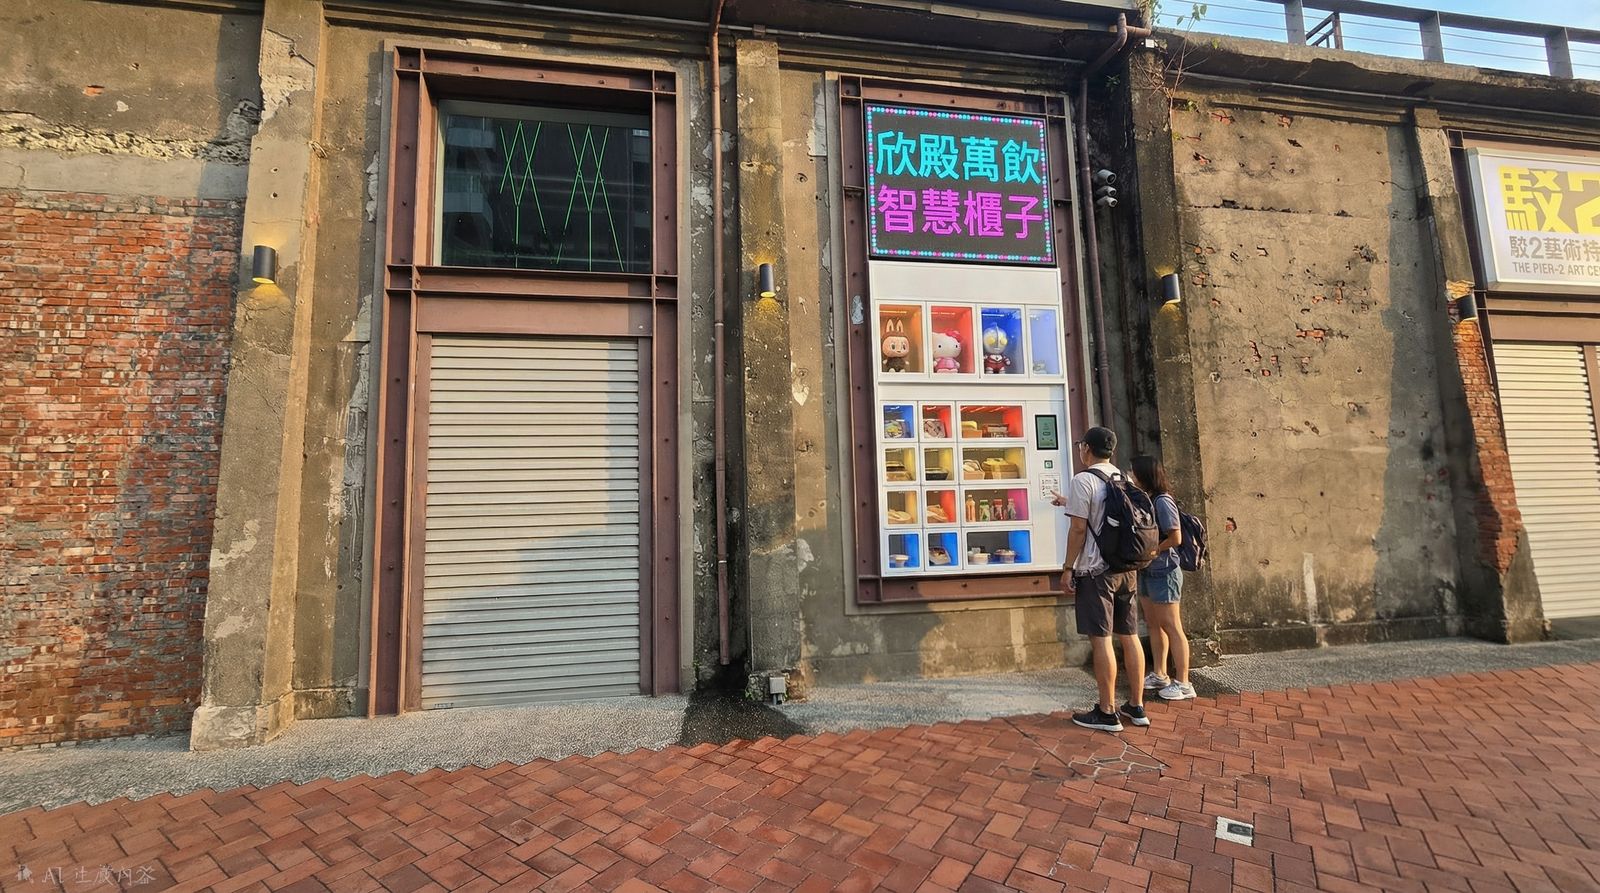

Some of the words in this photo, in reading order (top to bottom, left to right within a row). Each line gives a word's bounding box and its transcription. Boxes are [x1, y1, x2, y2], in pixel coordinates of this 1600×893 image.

[876, 130, 1042, 184] 欣殿萬飲
[877, 184, 1043, 239] 智慧櫃子
[1513, 262, 1531, 273] THE
[1533, 263, 1565, 275] PIER-2
[1567, 265, 1585, 276] ART
[1587, 265, 1600, 277] CE
